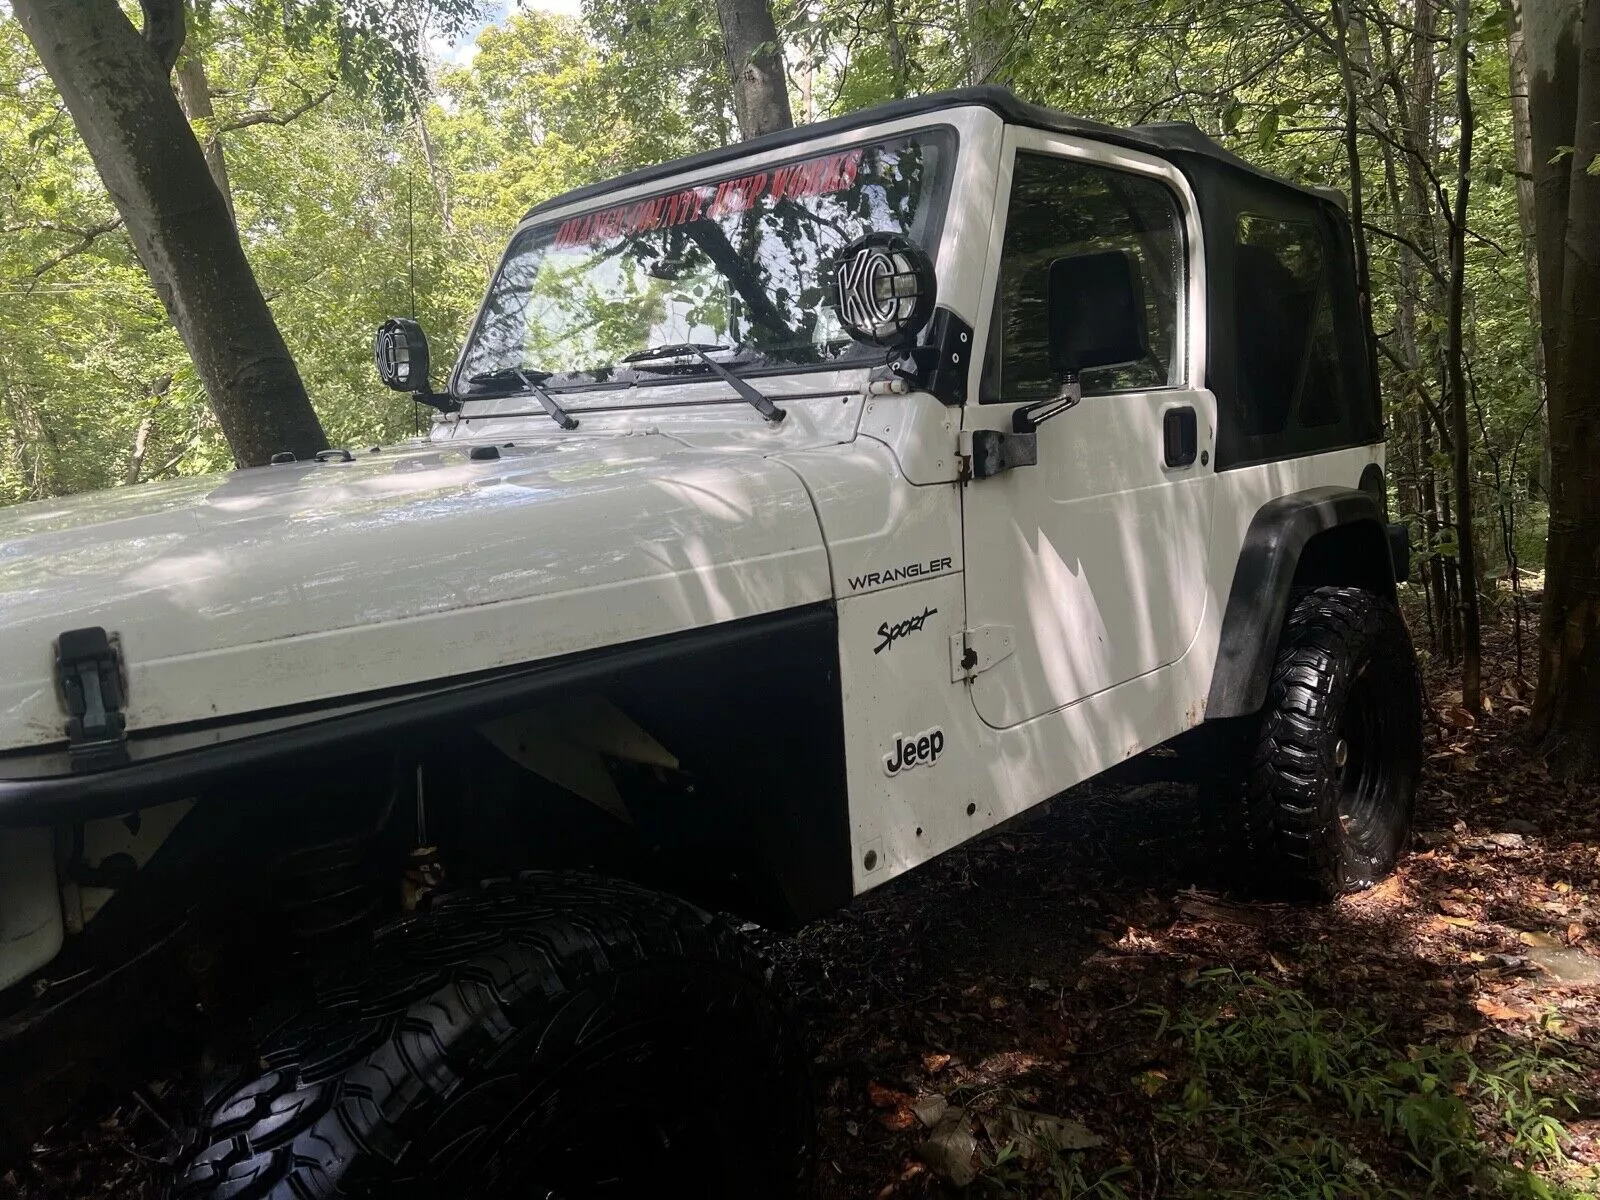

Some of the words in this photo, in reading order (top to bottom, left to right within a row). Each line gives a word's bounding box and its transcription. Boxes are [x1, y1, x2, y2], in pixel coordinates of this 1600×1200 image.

[625, 190, 704, 236] COUNTY
[706, 173, 767, 220] JEEP
[772, 149, 863, 204] WORKS
[838, 249, 898, 331] KC
[848, 557, 952, 590] WRANGLER
[873, 606, 938, 655] Sport
[886, 730, 944, 773] Jeep
